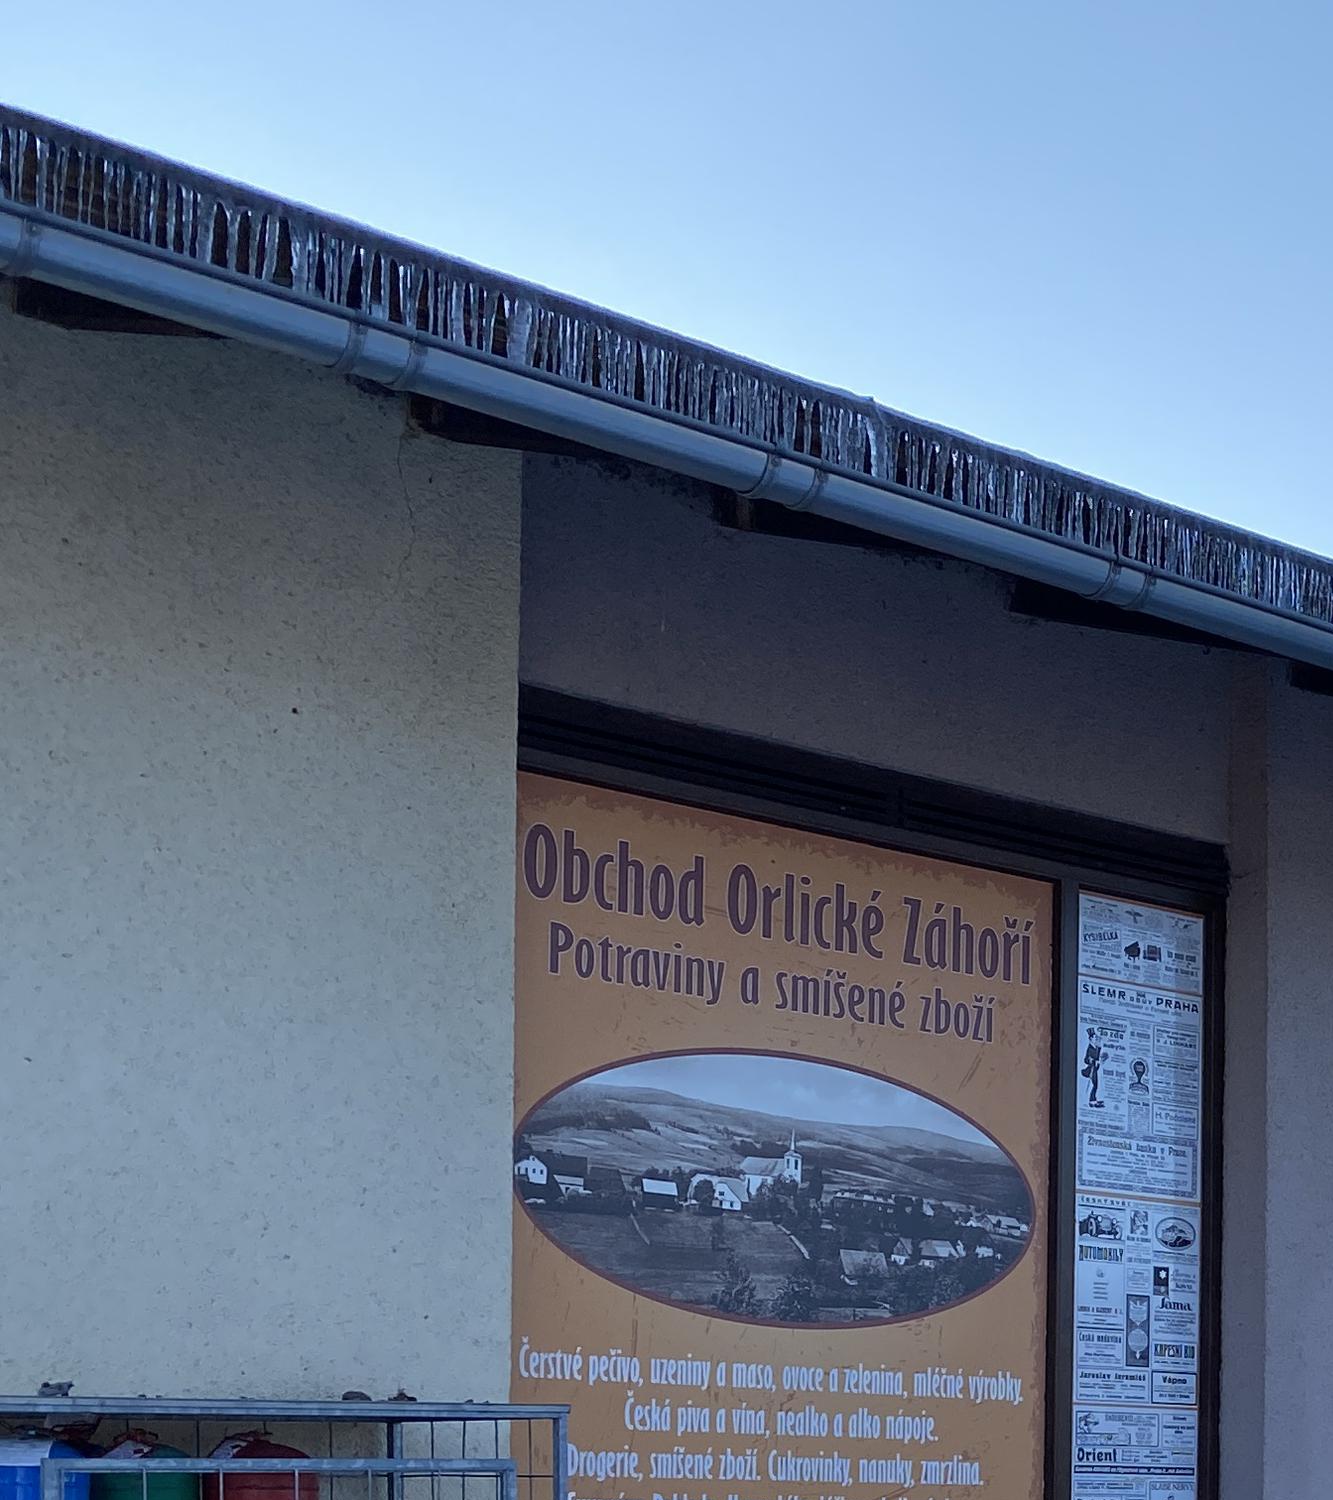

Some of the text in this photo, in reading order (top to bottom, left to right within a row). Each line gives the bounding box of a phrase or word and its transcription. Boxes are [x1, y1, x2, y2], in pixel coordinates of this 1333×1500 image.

[522, 823, 1035, 987] Obchod Orlické Záhoří
[547, 920, 996, 1045] Potraviny a smíšené zboží
[1156, 996, 1199, 1014] PRAHA
[1078, 1245, 1124, 1262] AUTOMOBILY
[519, 1336, 1023, 1406] Čerstvé pečivo, uzeniny a maso, ovoce a zelenina, mléčné výrobky.
[624, 1389, 939, 1444] Česká piva a vína, nealko a alko nápoje.
[567, 1442, 984, 1488] Drogerie, smíšené zboží. Cukrovinky, nanuky, zmrzlina.
[1076, 1447, 1117, 1463] Orient
